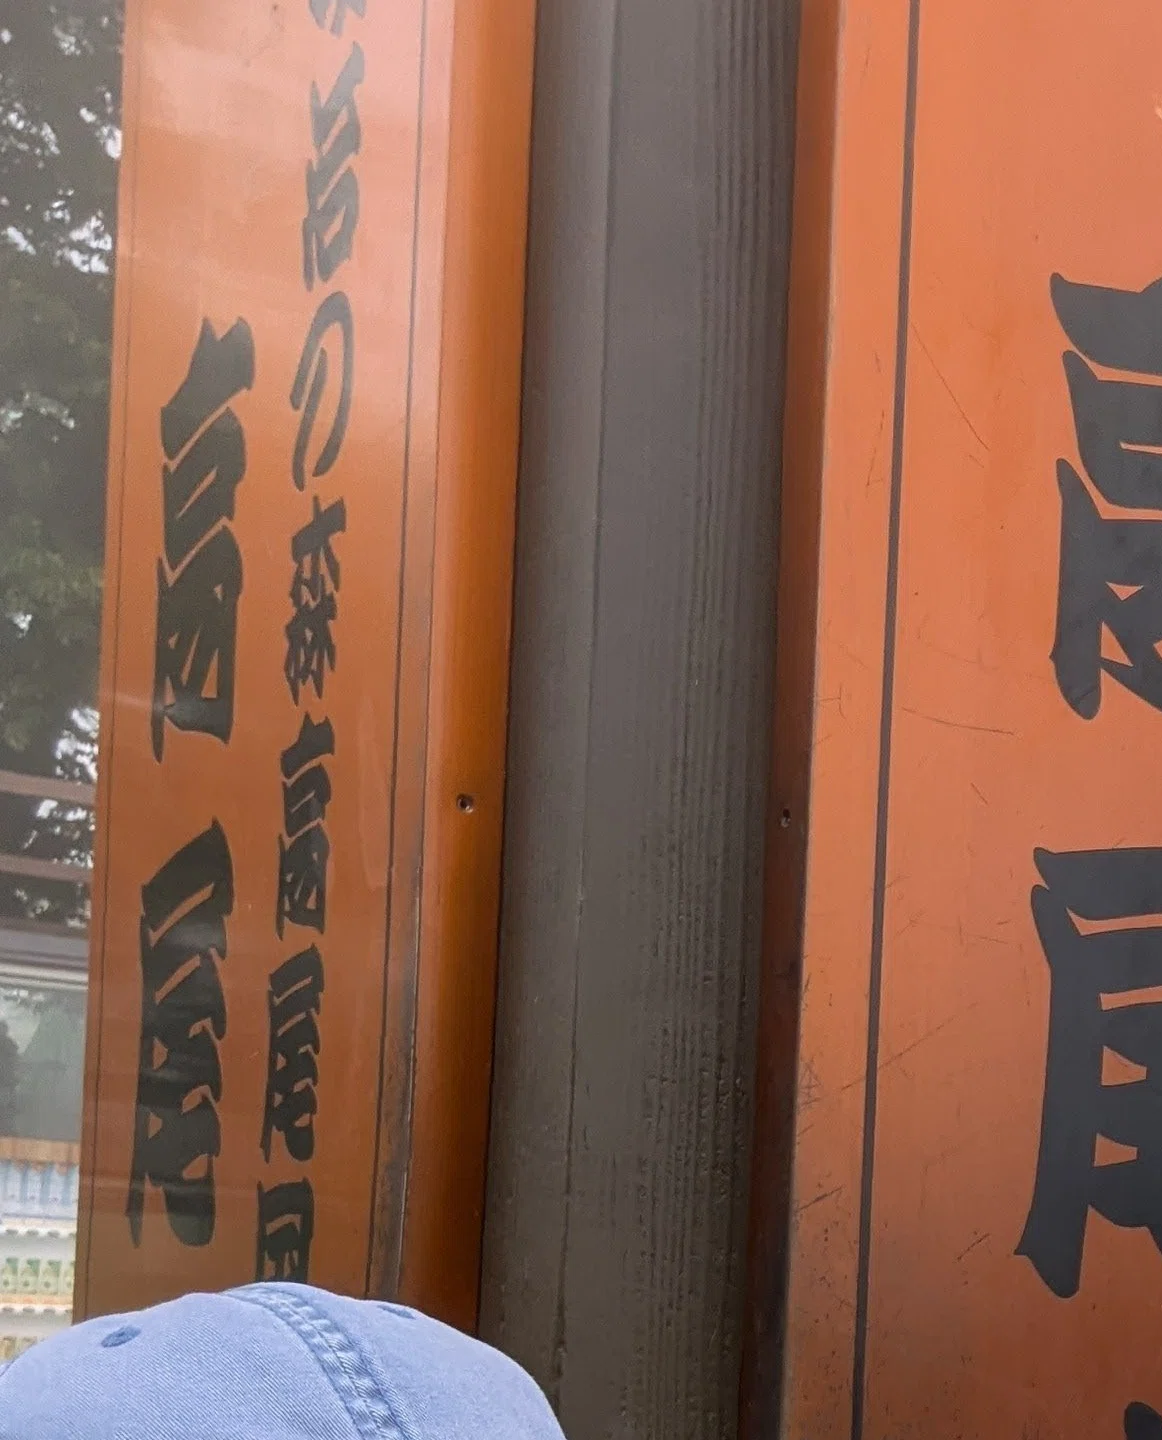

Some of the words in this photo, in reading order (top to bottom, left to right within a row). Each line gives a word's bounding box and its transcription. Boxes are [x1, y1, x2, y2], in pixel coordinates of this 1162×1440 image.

[256, 0, 366, 1284] 治の森高尾
